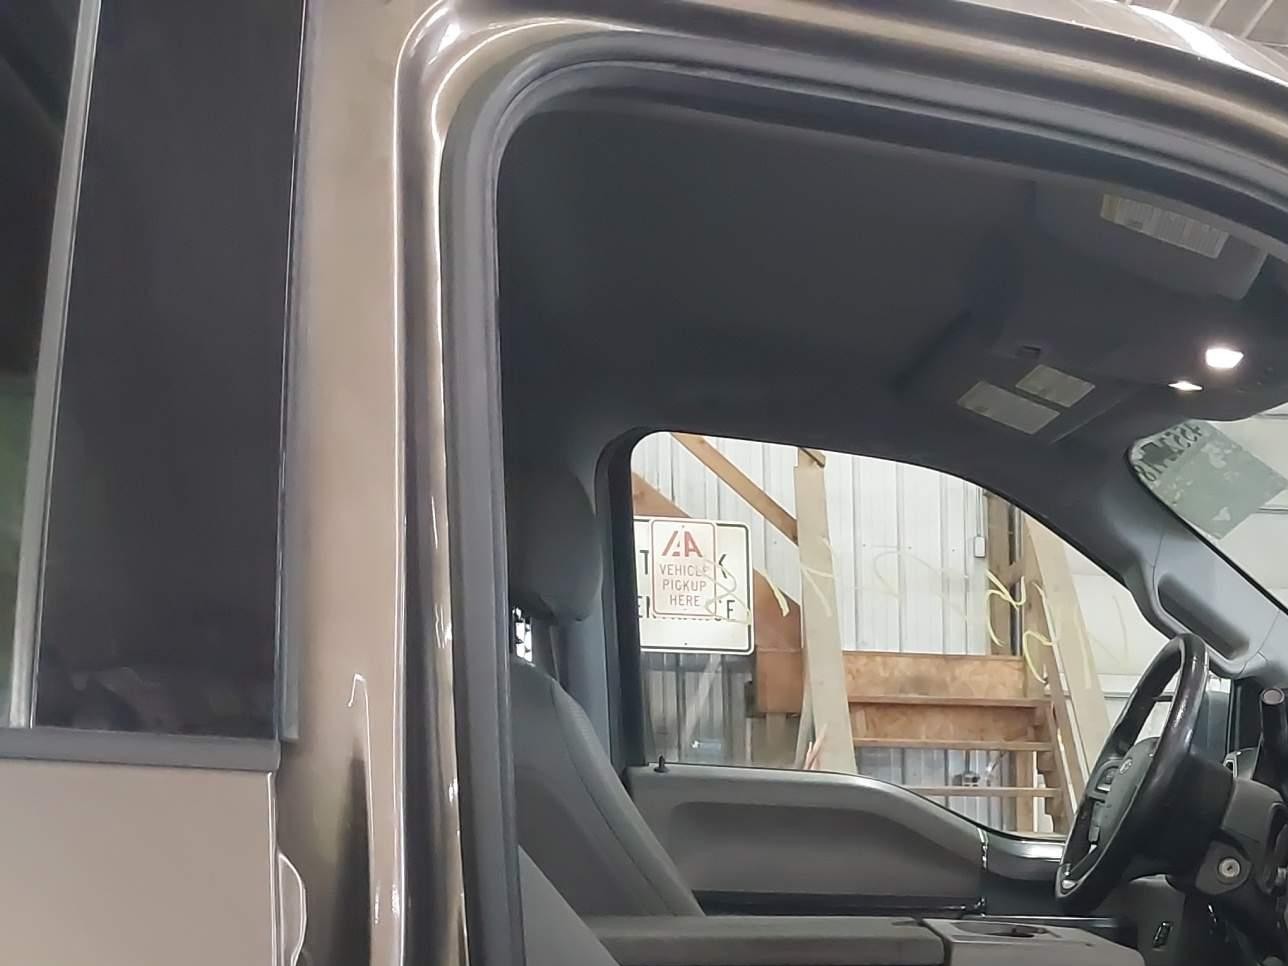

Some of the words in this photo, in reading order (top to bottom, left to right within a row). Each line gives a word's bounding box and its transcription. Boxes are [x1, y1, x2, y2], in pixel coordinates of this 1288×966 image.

[659, 564, 710, 577] VEHICLE
[662, 580, 707, 592] PICKUP
[670, 595, 701, 607] HERE
